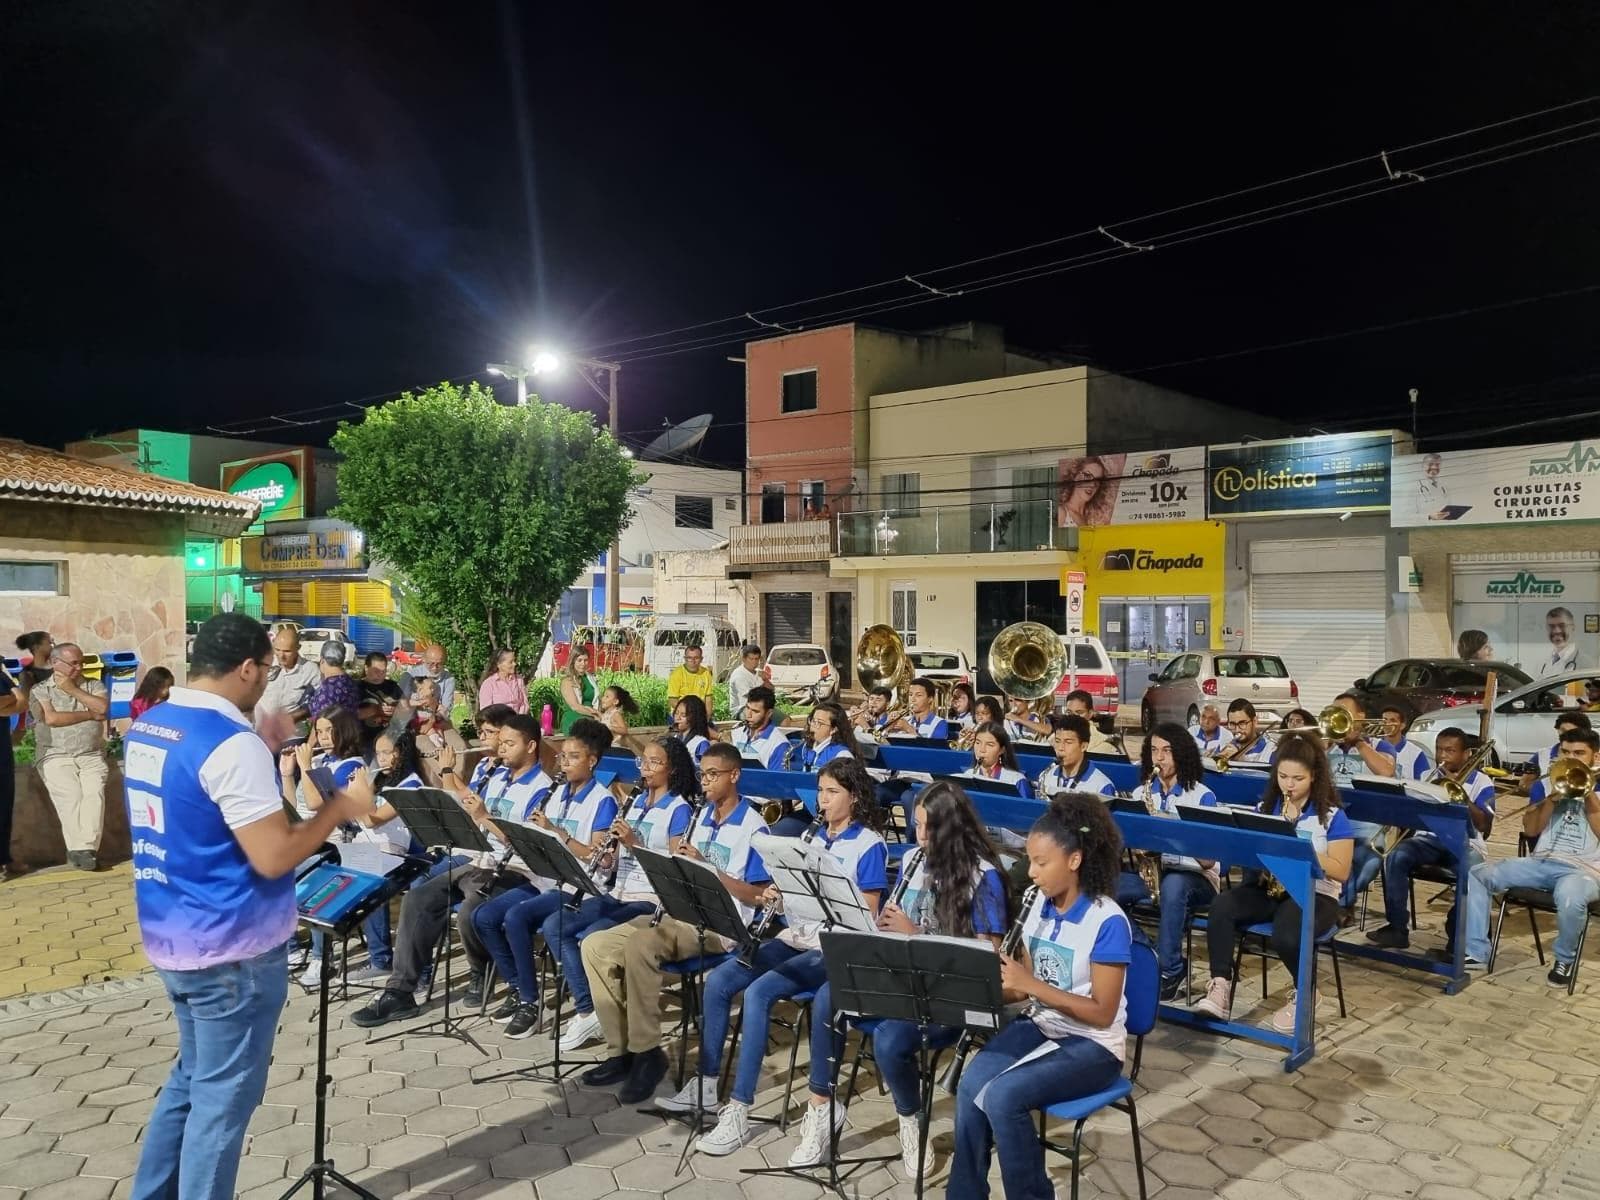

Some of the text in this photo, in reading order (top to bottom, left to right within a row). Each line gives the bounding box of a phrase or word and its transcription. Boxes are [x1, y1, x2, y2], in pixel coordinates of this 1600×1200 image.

[1132, 465, 1179, 478] Chapada
[1150, 482, 1187, 503] 10x
[1493, 481, 1582, 496] CONSULTAS
[1494, 494, 1580, 507] CIRURGIAS
[1506, 507, 1567, 518] EXAMES
[1136, 553, 1204, 573] Chapada
